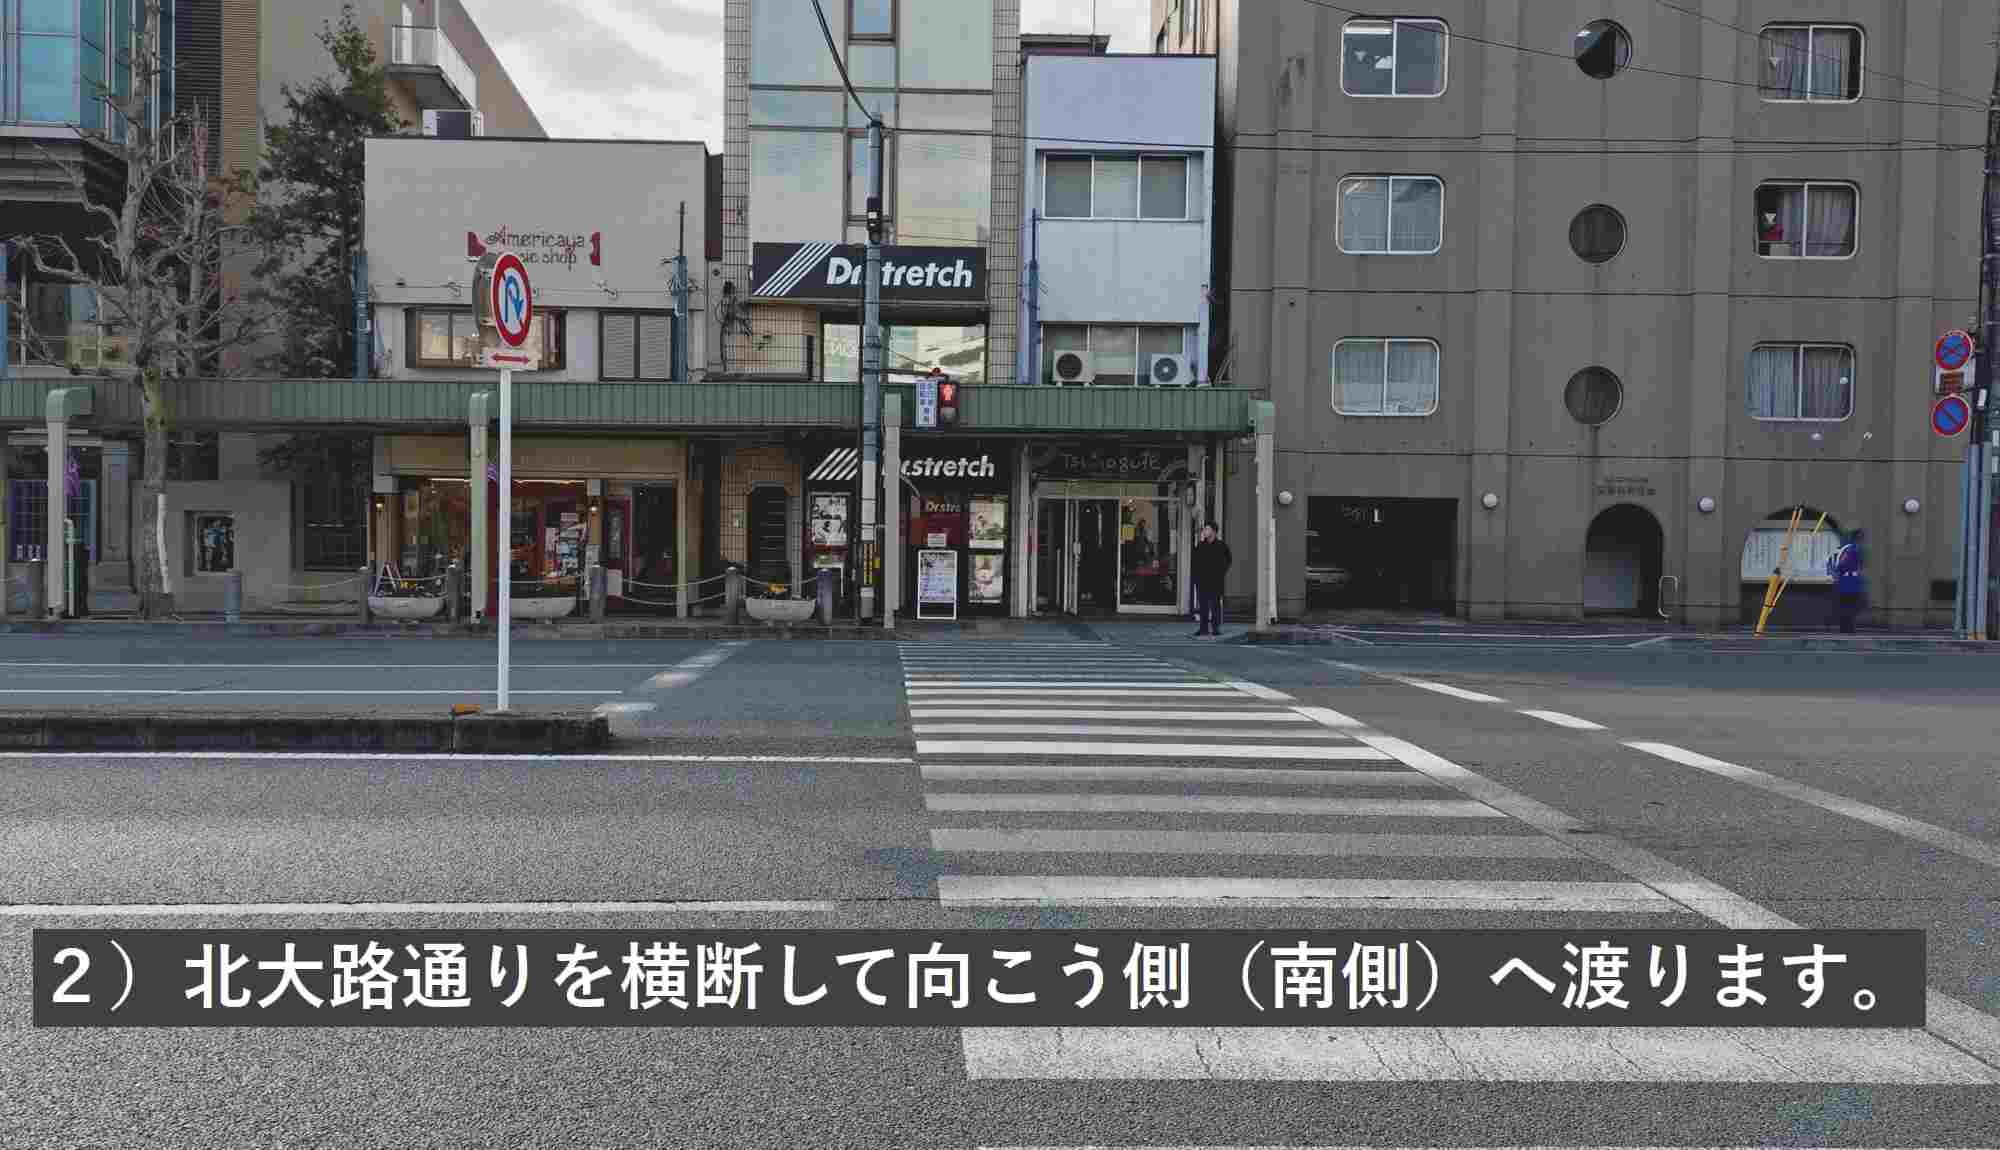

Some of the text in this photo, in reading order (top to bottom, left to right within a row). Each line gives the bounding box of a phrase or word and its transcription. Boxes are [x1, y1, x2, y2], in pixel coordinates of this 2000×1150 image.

[486, 224, 585, 253] Americaya
[541, 247, 577, 272] shop
[826, 256, 974, 289] Drtretch
